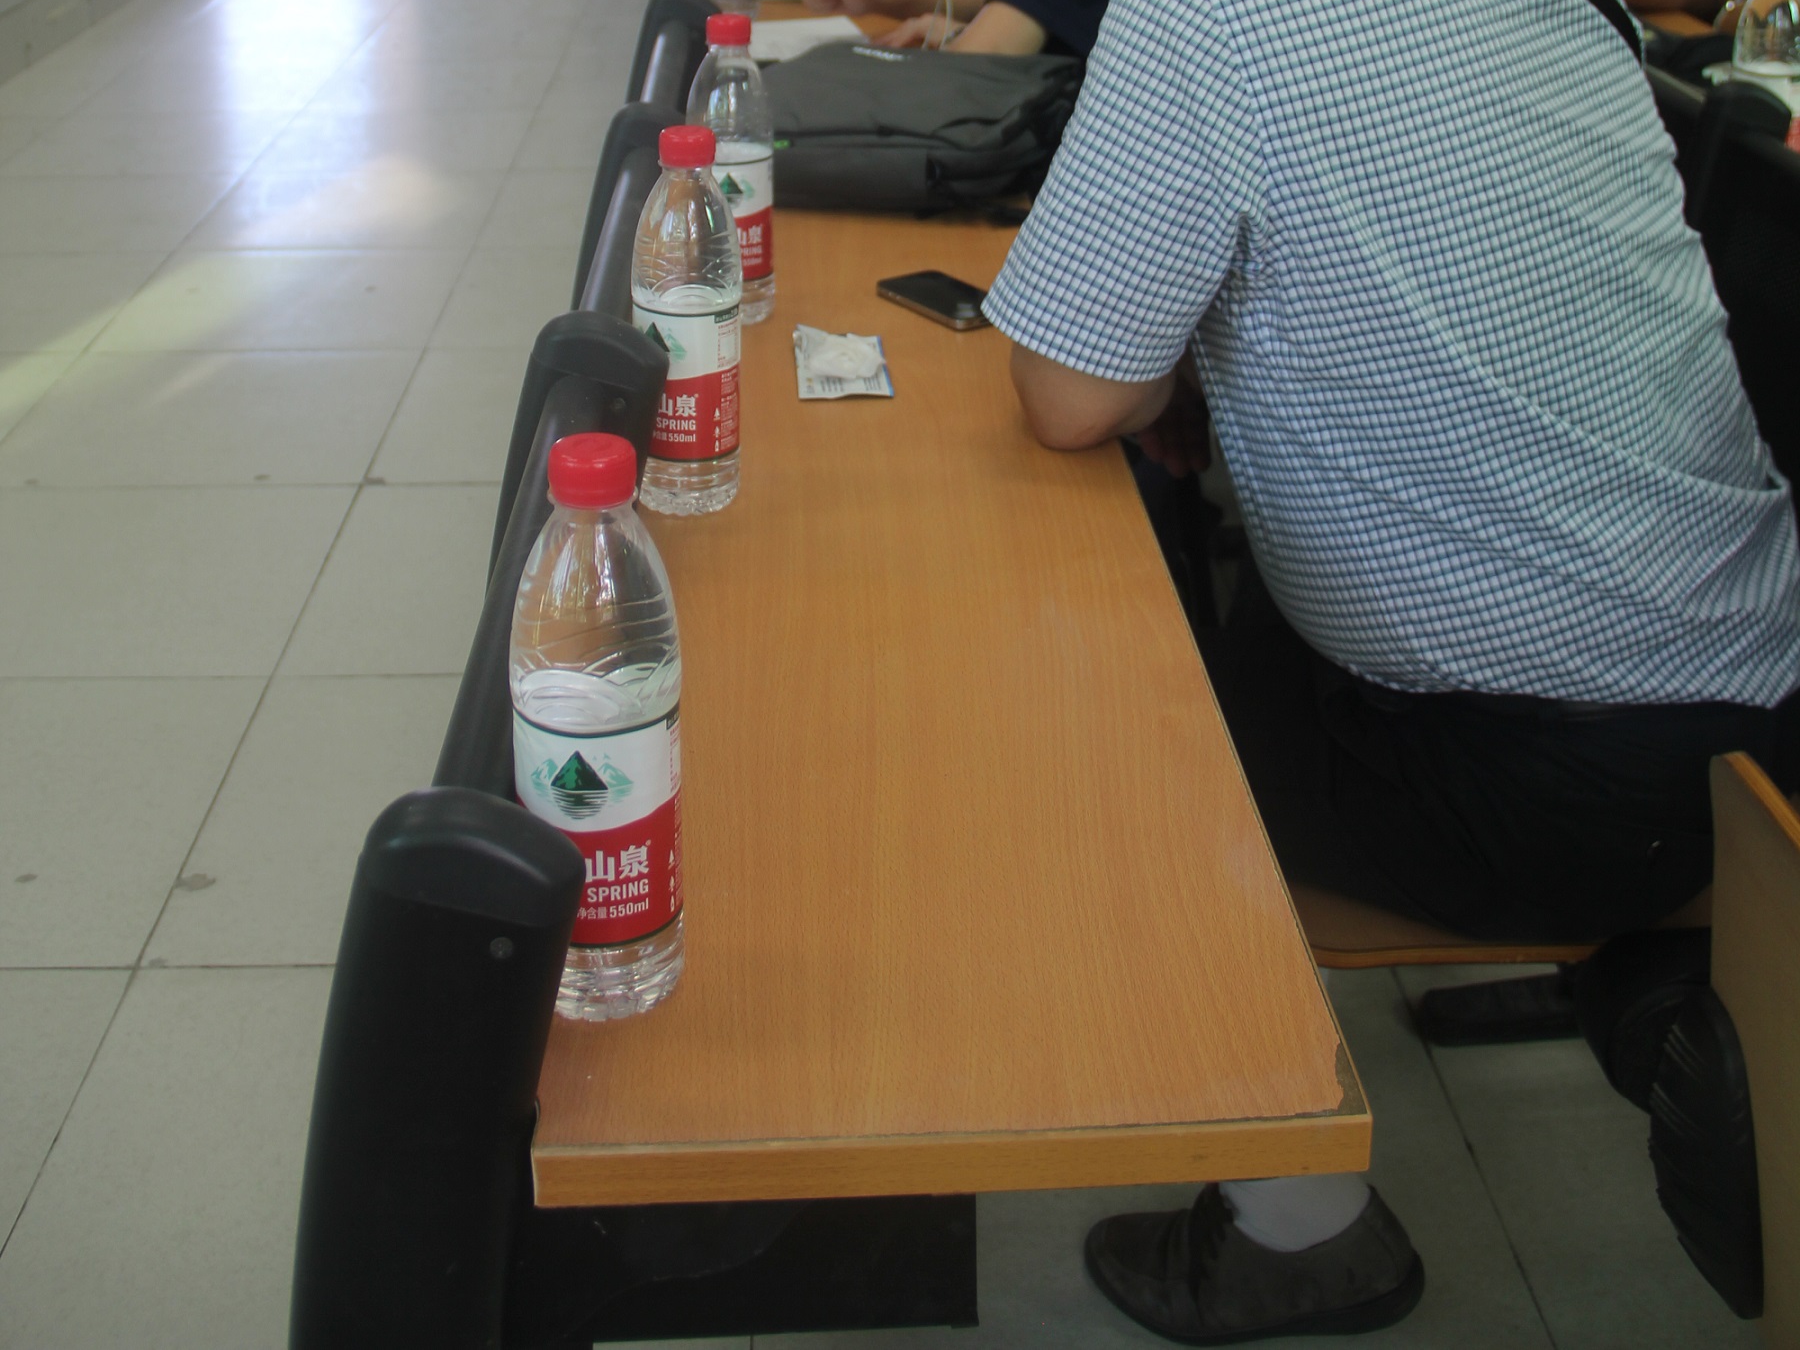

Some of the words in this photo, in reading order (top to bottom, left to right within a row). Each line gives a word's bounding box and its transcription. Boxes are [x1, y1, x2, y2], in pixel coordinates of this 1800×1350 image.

[656, 417, 697, 431] SPRING
[584, 844, 650, 883] 山泉
[587, 878, 649, 903] SPRING
